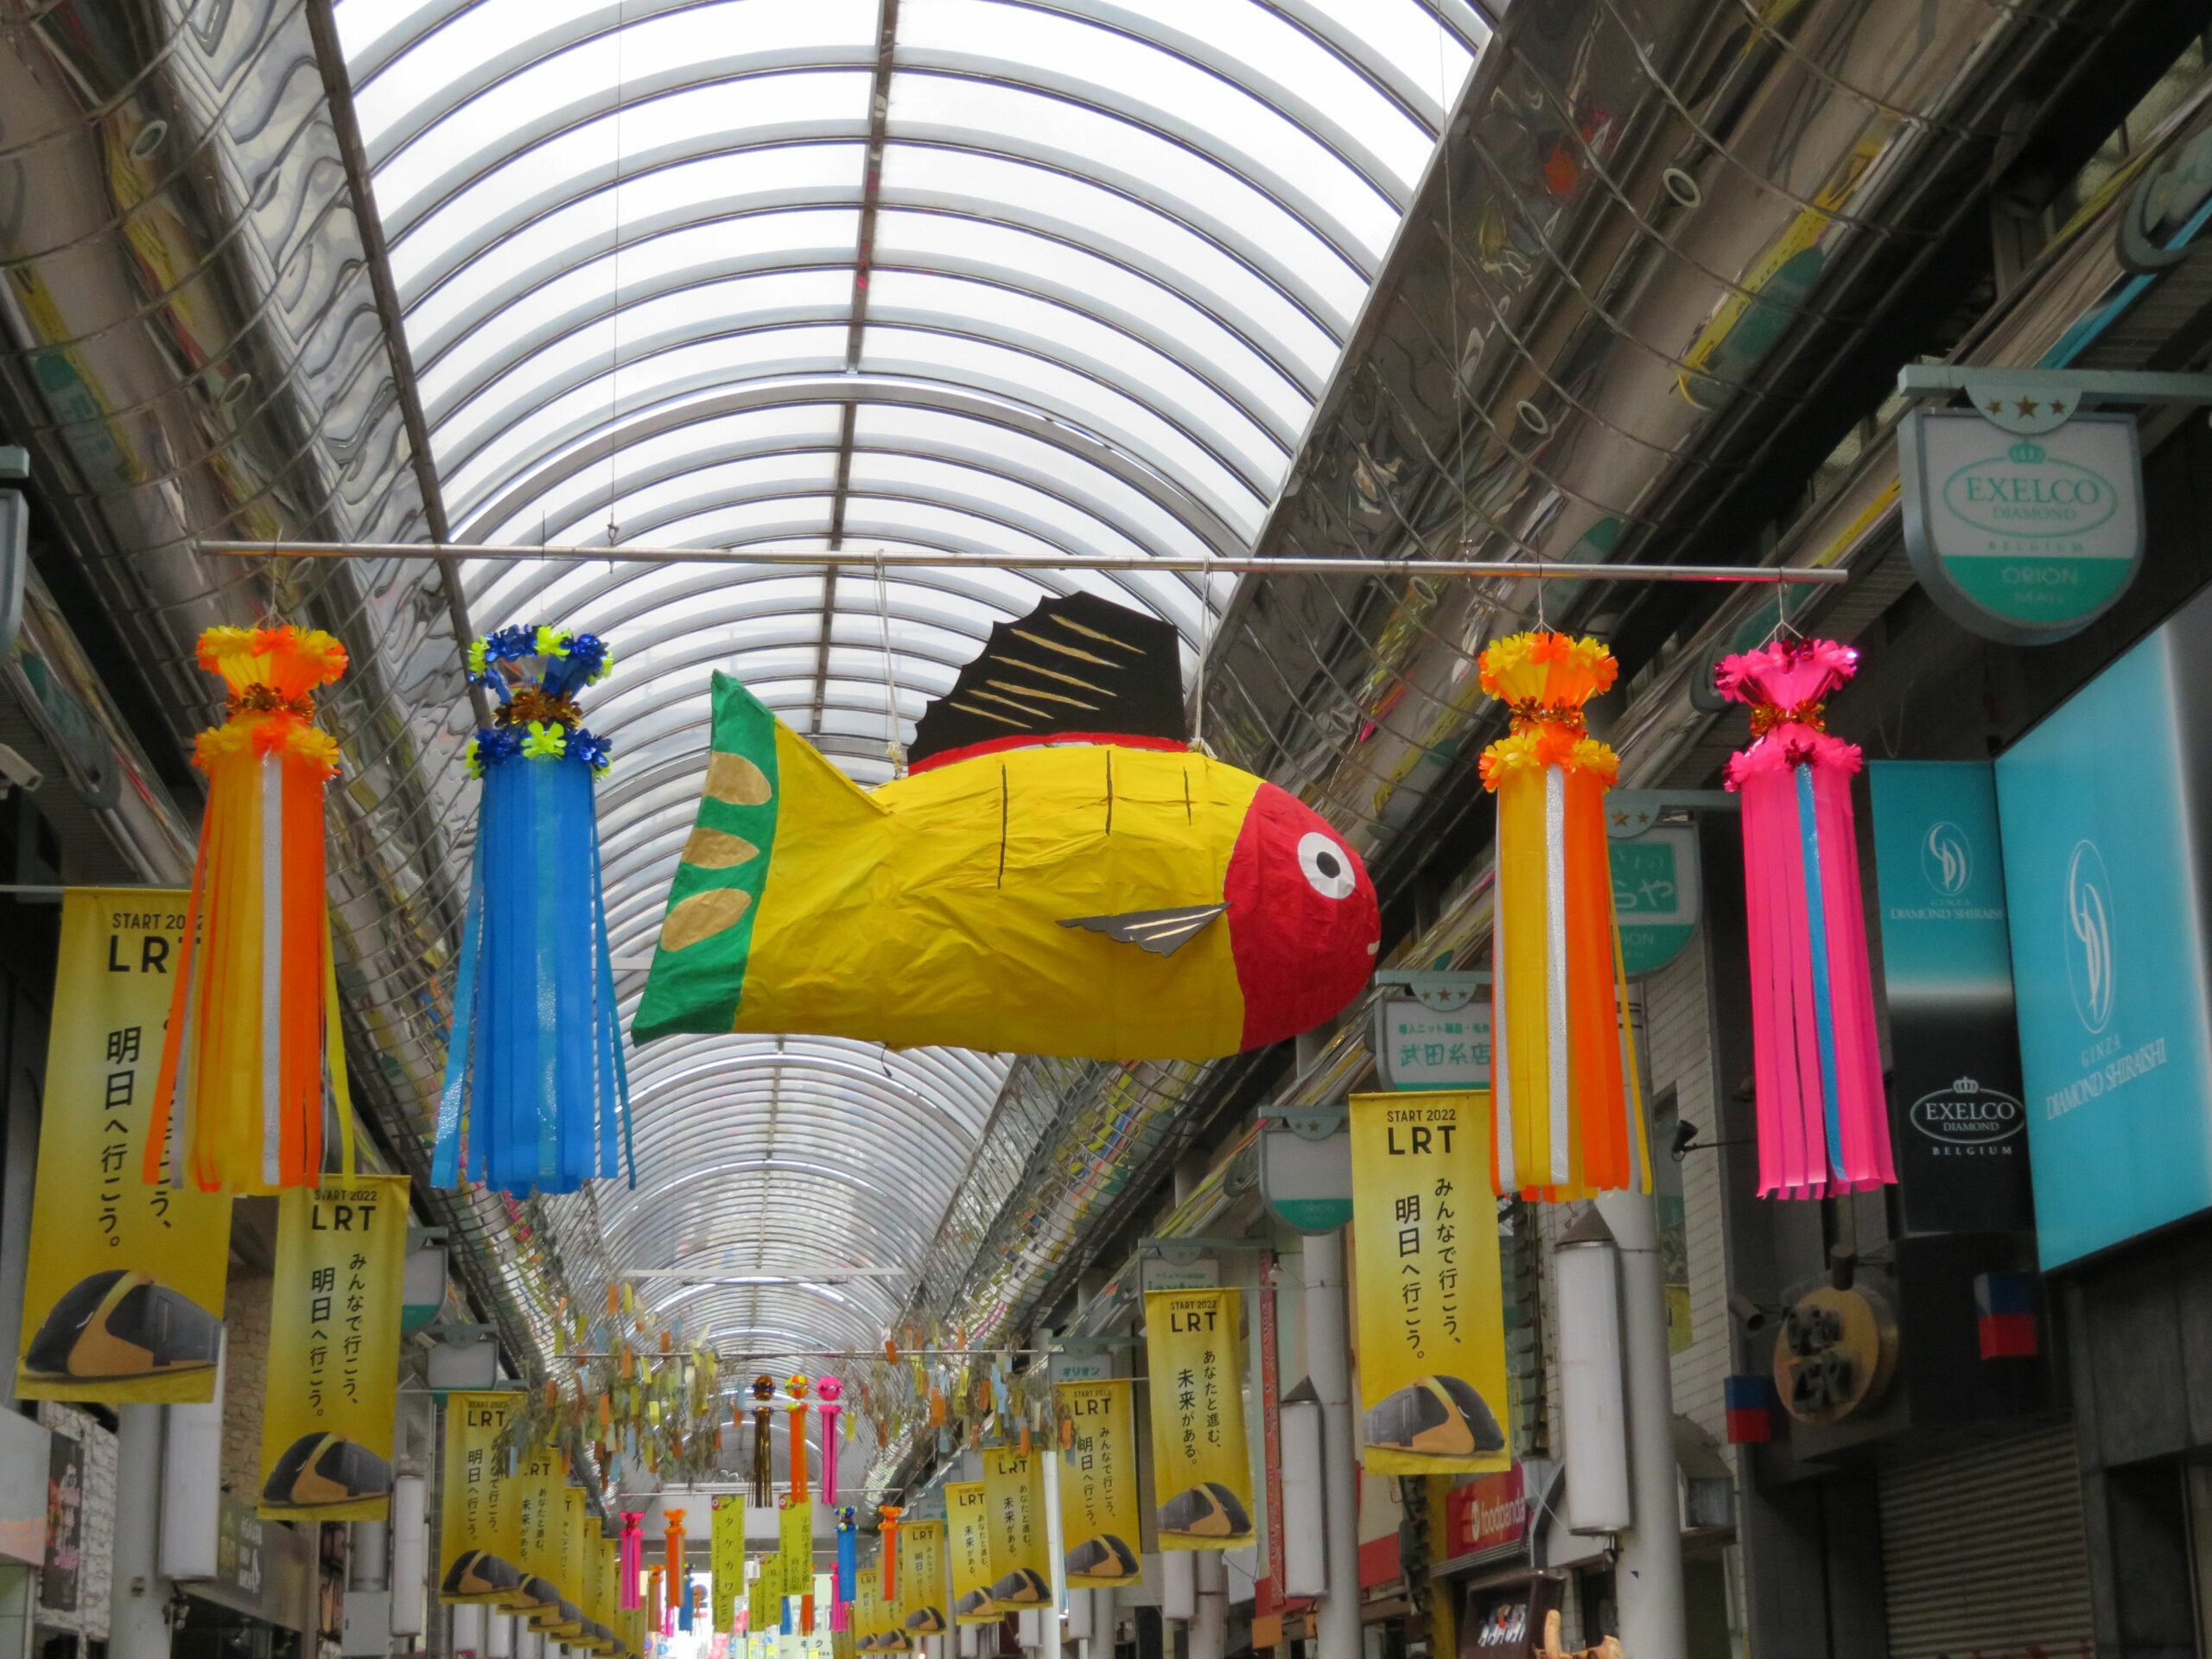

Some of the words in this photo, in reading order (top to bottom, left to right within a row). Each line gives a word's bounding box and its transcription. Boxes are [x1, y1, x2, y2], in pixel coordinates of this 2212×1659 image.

[1966, 477, 2101, 504] EXELCO
[1993, 506, 2076, 520] DIAMOND
[1988, 541, 2082, 551] BELGIUM
[2002, 567, 2079, 585] ORION
[111, 912, 162, 931] START
[1891, 908, 1951, 919] DIAMOND
[1400, 1042, 1491, 1067] 武田糸店
[2081, 1033, 2121, 1067] GINZA
[2046, 1071, 2104, 1121] DIAMOND
[2105, 1036, 2167, 1091] SHIRAISHI
[1387, 1110, 1423, 1122] START
[1427, 1109, 1457, 1122] 2022
[1924, 1102, 2016, 1121] EXELCO
[99, 1026, 143, 1248] 明日へ行こう。
[1943, 1122, 2000, 1132] DIAMOND
[1388, 1125, 1457, 1155] LRT
[1932, 1146, 2013, 1156] BELGIUM
[349, 1190, 377, 1202] 2022
[311, 1205, 377, 1231] LRT
[1434, 1177, 1462, 1344] みんなで行こう、
[1395, 1194, 1425, 1359] 明日へ行こう。
[1171, 1301, 1195, 1311] START
[1197, 1300, 1217, 1309] 2022
[342, 1252, 366, 1404] みんなで行こう、
[1171, 1311, 1217, 1332] LRT
[308, 1267, 336, 1417] 明日へ行こう。
[1063, 1367, 1100, 1376] オリオン
[1074, 1389, 1093, 1398] START
[1203, 1350, 1222, 1448] あなたと進む、
[1074, 1398, 1112, 1416] LRT
[1177, 1368, 1198, 1465] 未来がある。
[467, 1410, 505, 1427] LRT
[998, 1459, 1027, 1475] LRT
[1099, 1427, 1116, 1517] みんなで行こう、
[1079, 1437, 1097, 1526] 明日へ行こう。
[467, 1448, 483, 1541] 明日へ行こう。
[959, 1492, 985, 1507] LRT
[1019, 1485, 1033, 1548] あなたと進む、
[1480, 1487, 1525, 1541] foodpanda
[912, 1529, 934, 1541] LRT
[1003, 1497, 1018, 1558] 未来がある。
[861, 1575, 877, 1585] LRT
